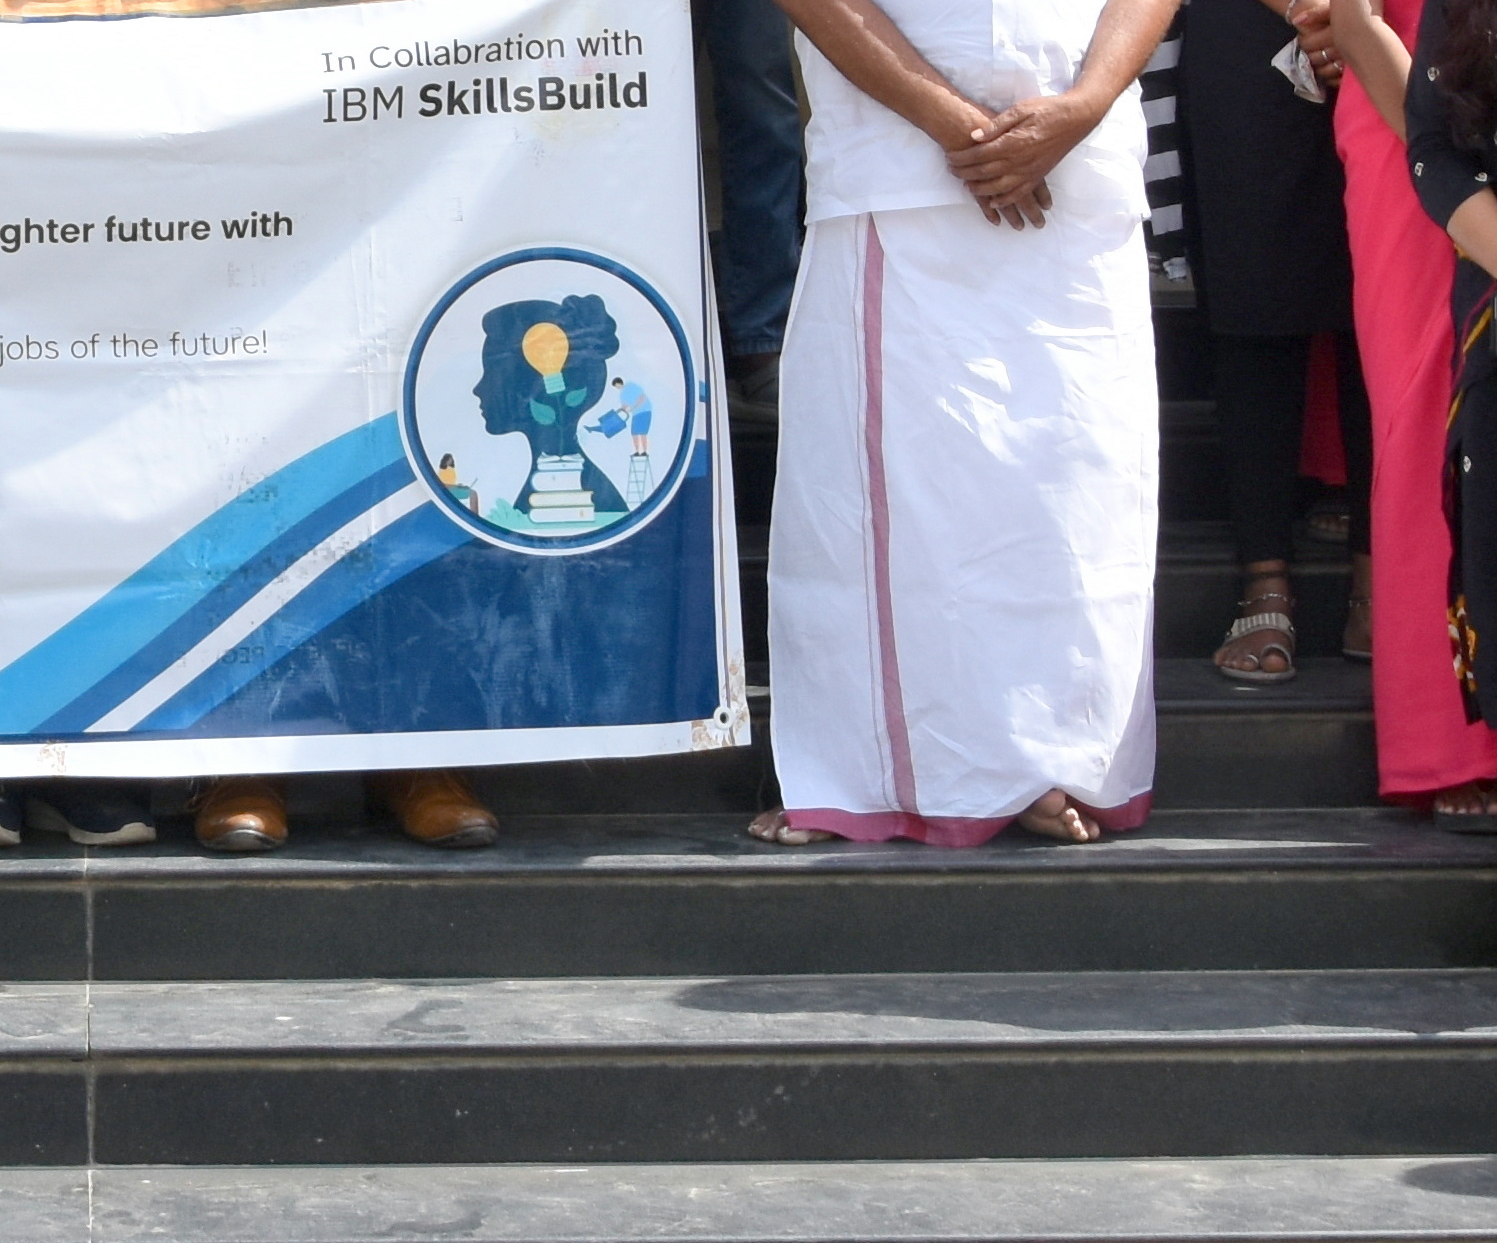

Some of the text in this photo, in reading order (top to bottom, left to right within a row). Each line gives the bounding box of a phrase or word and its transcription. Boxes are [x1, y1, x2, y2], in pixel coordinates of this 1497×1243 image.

[322, 28, 643, 73] In Collabration with
[323, 71, 648, 123] IBM SkillsBuild
[105, 215, 211, 243] future
[221, 211, 293, 239] with
[71, 333, 100, 359] of
[110, 332, 158, 359] the
[170, 330, 269, 357] future!
